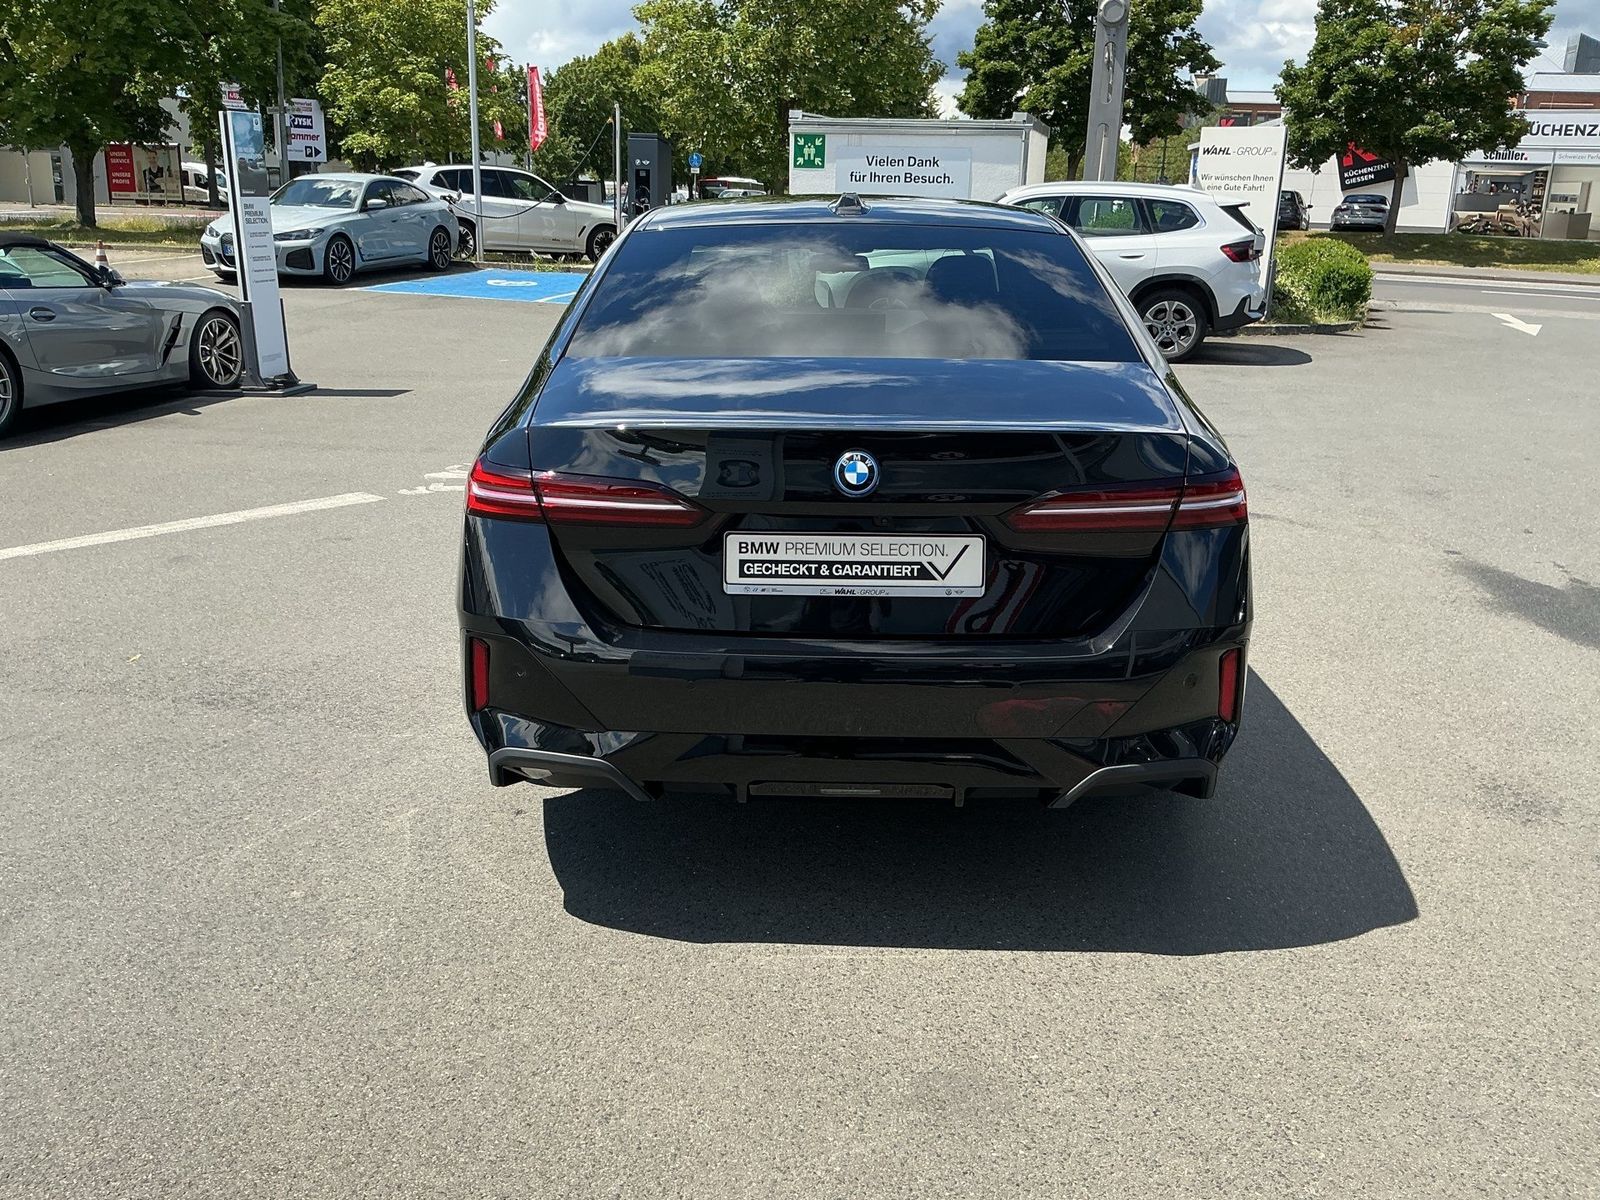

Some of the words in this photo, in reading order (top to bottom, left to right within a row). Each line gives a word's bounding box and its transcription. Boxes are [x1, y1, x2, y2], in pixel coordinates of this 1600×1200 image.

[294, 117, 312, 127] JYSK
[1529, 120, 1600, 137] ÜCHENZ
[291, 133, 320, 141] ammer
[866, 155, 904, 167] Vielen
[908, 156, 940, 168] Dank
[1344, 162, 1390, 178] KÜCHENZENT
[850, 171, 867, 182] für
[869, 172, 901, 183] Ihren
[904, 172, 954, 184] Besuch.
[1201, 173, 1213, 181] Wir
[1214, 174, 1251, 182] wünschen
[1253, 174, 1274, 182] Ihnen
[1345, 173, 1375, 185] GIESSEN
[1206, 183, 1222, 191] eine
[1223, 183, 1241, 191] Gute
[1243, 183, 1265, 192] Fahrt!
[244, 210, 264, 218] PREMIUM
[738, 541, 779, 555] BMW
[785, 542, 855, 556] PREMIUM
[860, 543, 948, 557] SELECTION.
[743, 563, 818, 576] GECHECKT
[820, 564, 830, 576] &
[832, 564, 921, 577] GARANTIERT
